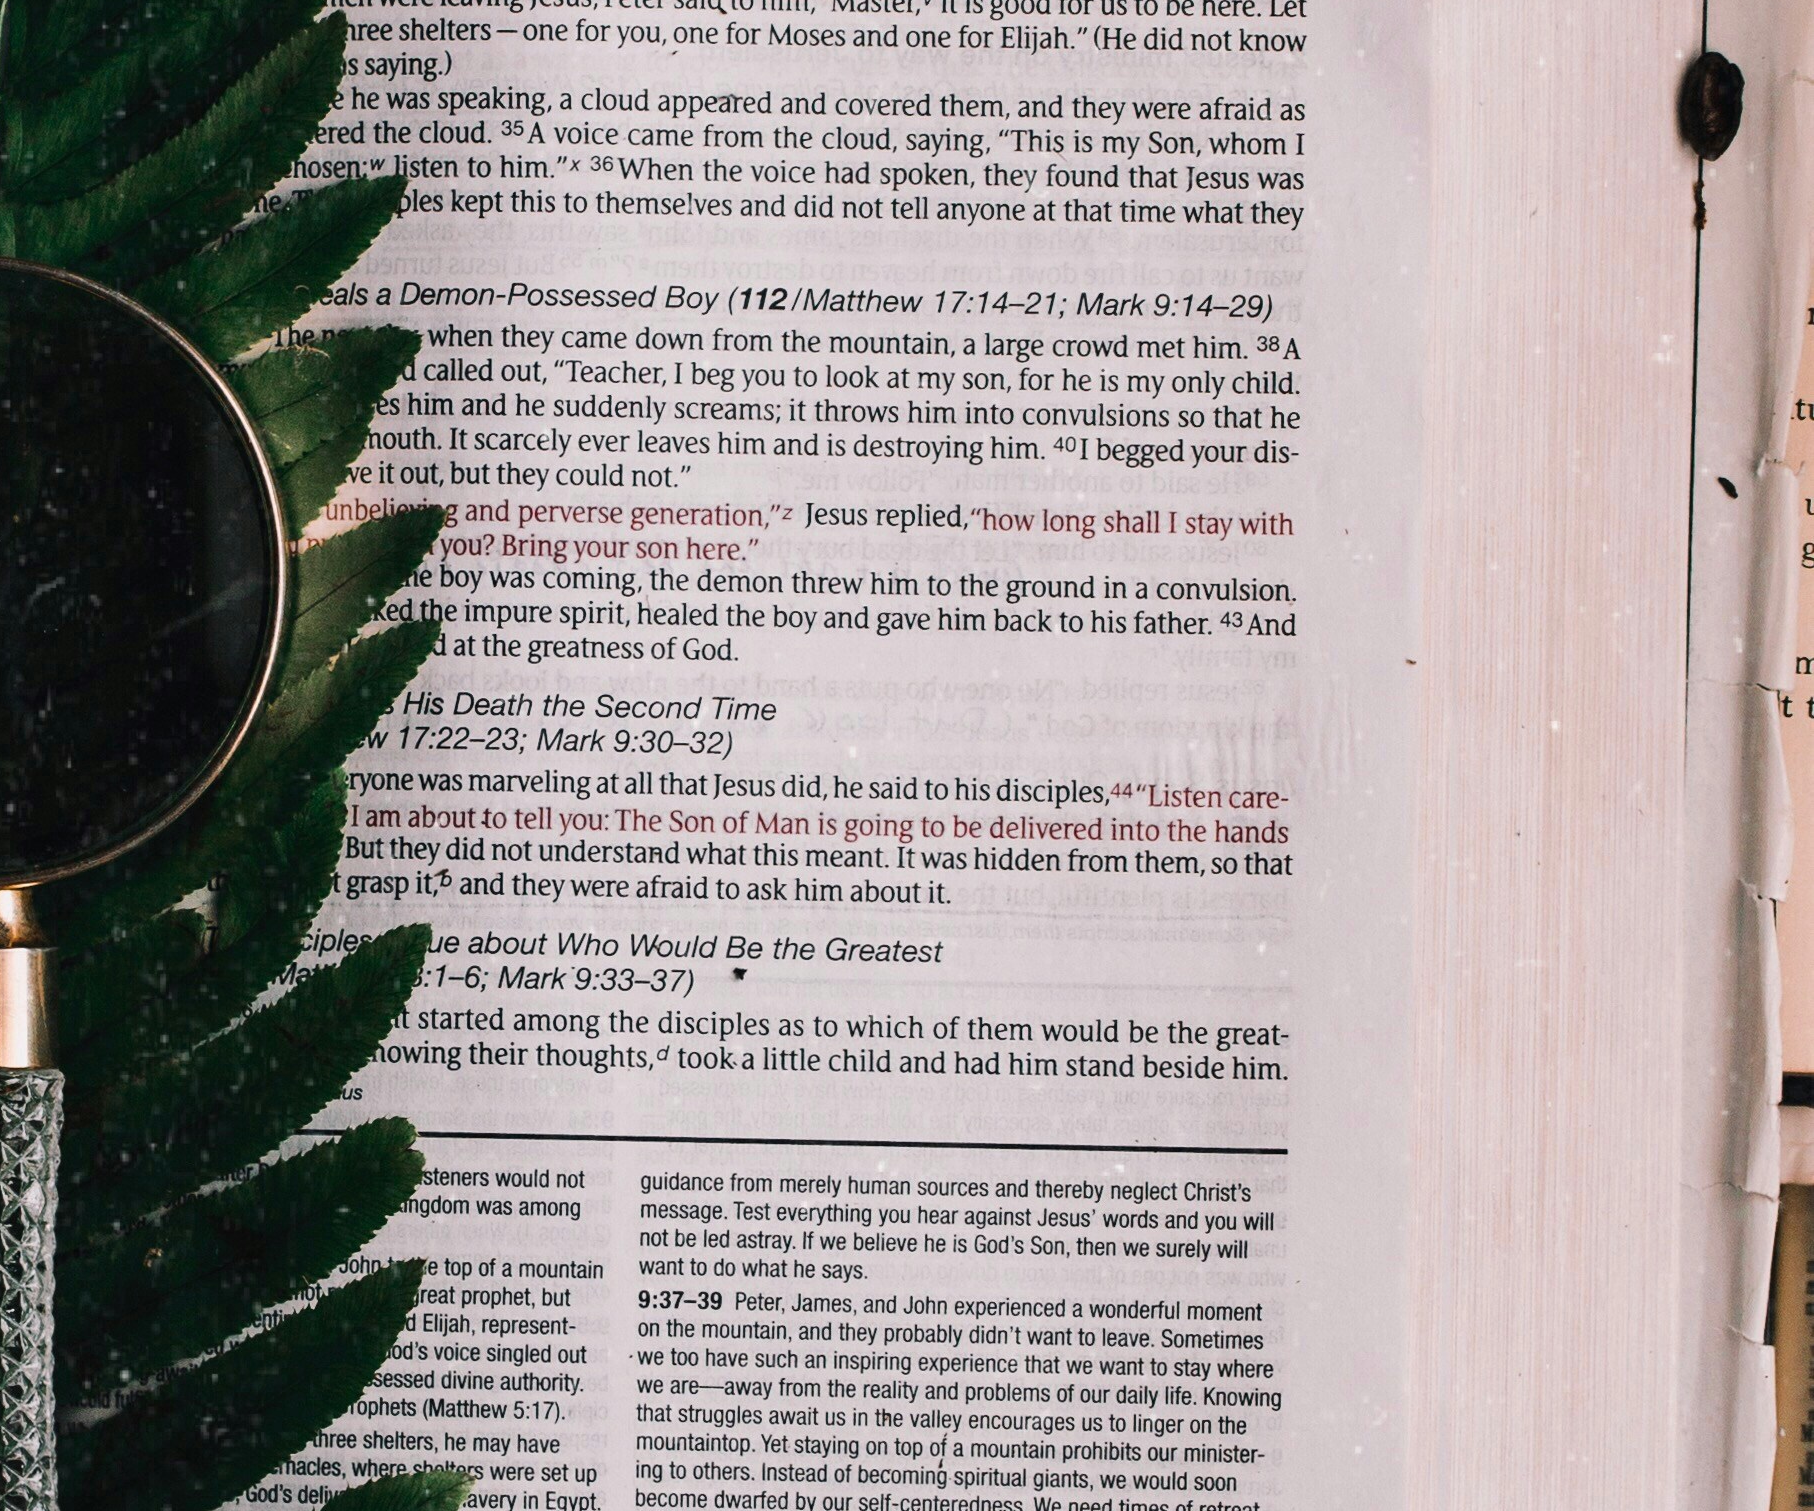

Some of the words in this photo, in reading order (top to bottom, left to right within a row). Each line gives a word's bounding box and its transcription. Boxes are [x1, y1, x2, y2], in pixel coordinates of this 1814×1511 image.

[736, 1292, 785, 1313] Peter,
[792, 1293, 856, 1315] James,
[864, 1296, 896, 1313] and
[903, 1296, 947, 1314] John
[955, 1298, 1065, 1319] experienced
[1073, 1303, 1083, 1317] a
[1089, 1300, 1180, 1319] wonderful
[1188, 1304, 1262, 1321] moment
